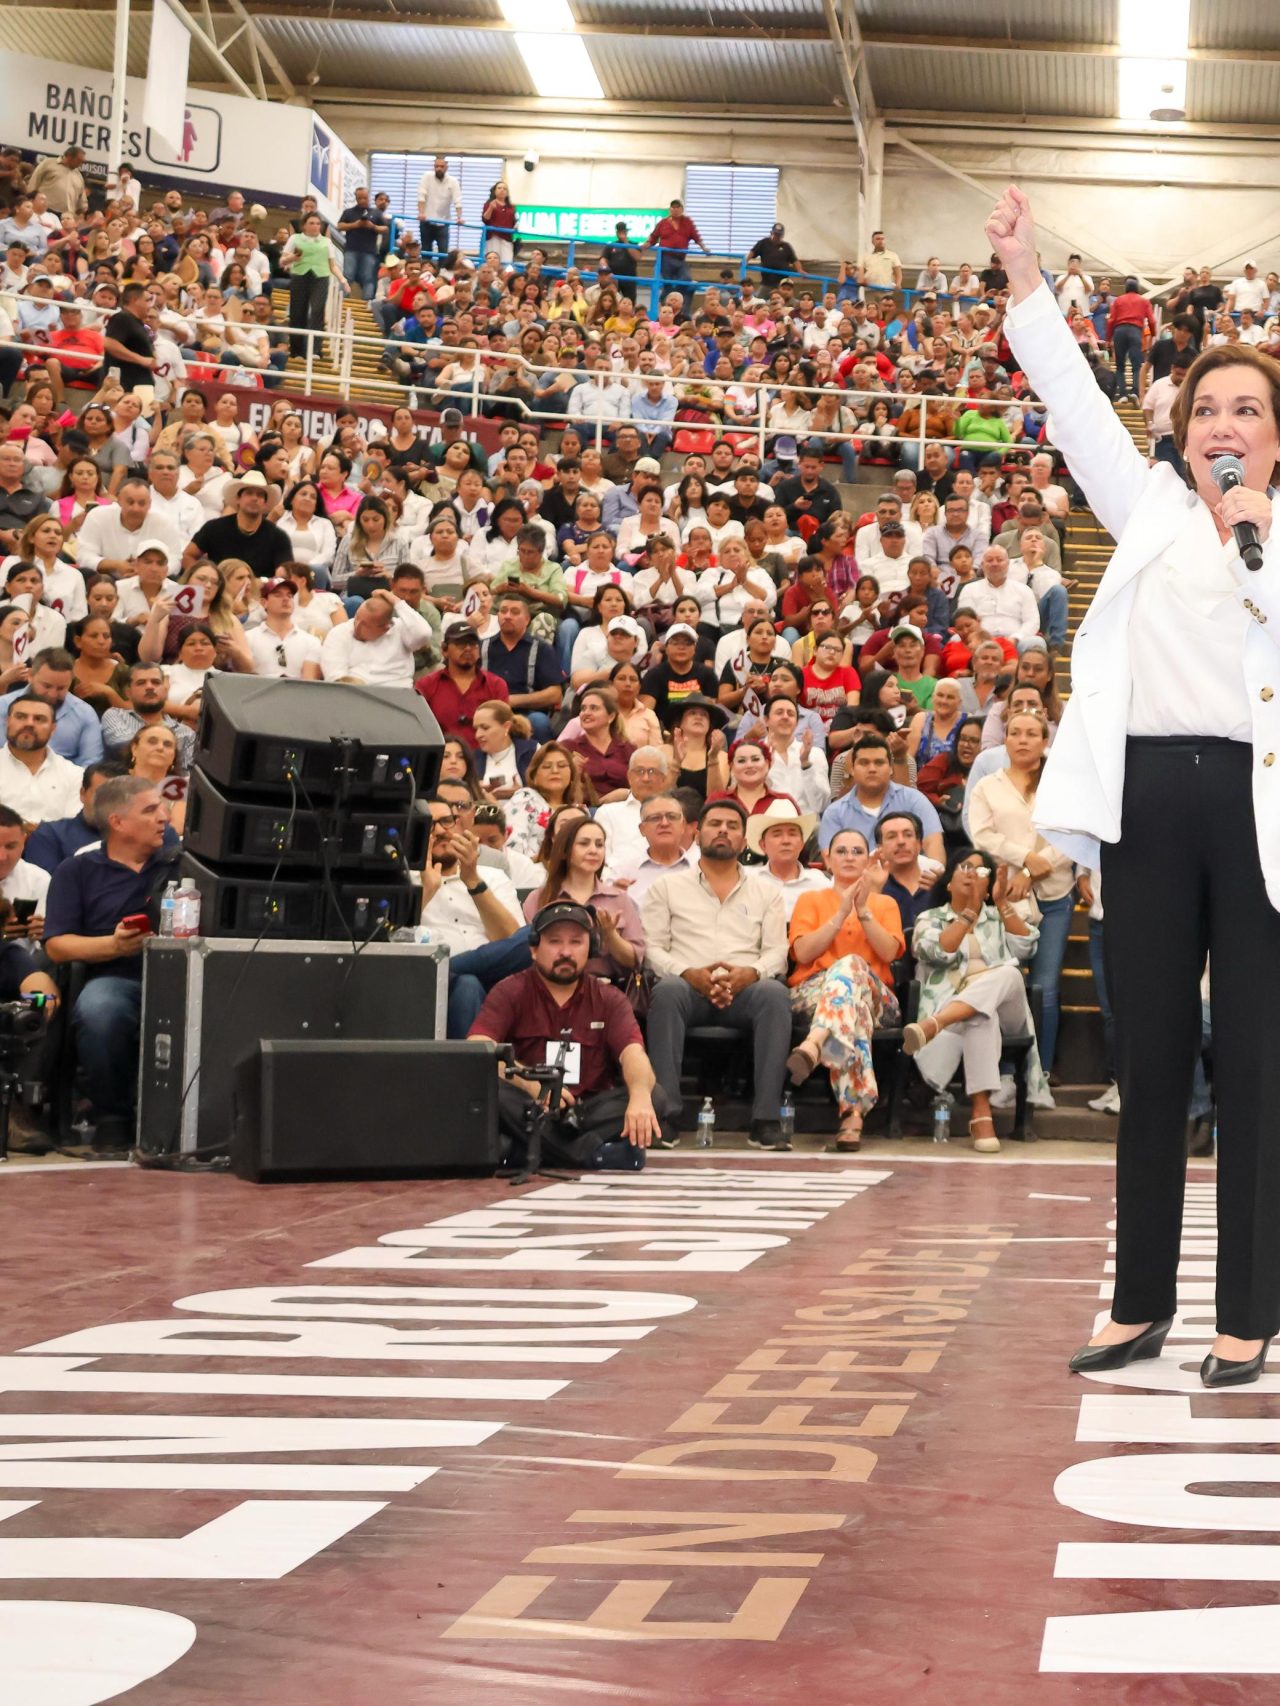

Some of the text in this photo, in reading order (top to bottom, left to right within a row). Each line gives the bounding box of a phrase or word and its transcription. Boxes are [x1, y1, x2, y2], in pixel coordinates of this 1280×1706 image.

[839, 1248, 1001, 1278] DE
[0, 1168, 894, 1706] ENTRO ESTATAL
[613, 1284, 981, 1483] DEFENSA
[441, 1510, 855, 1642] EN
